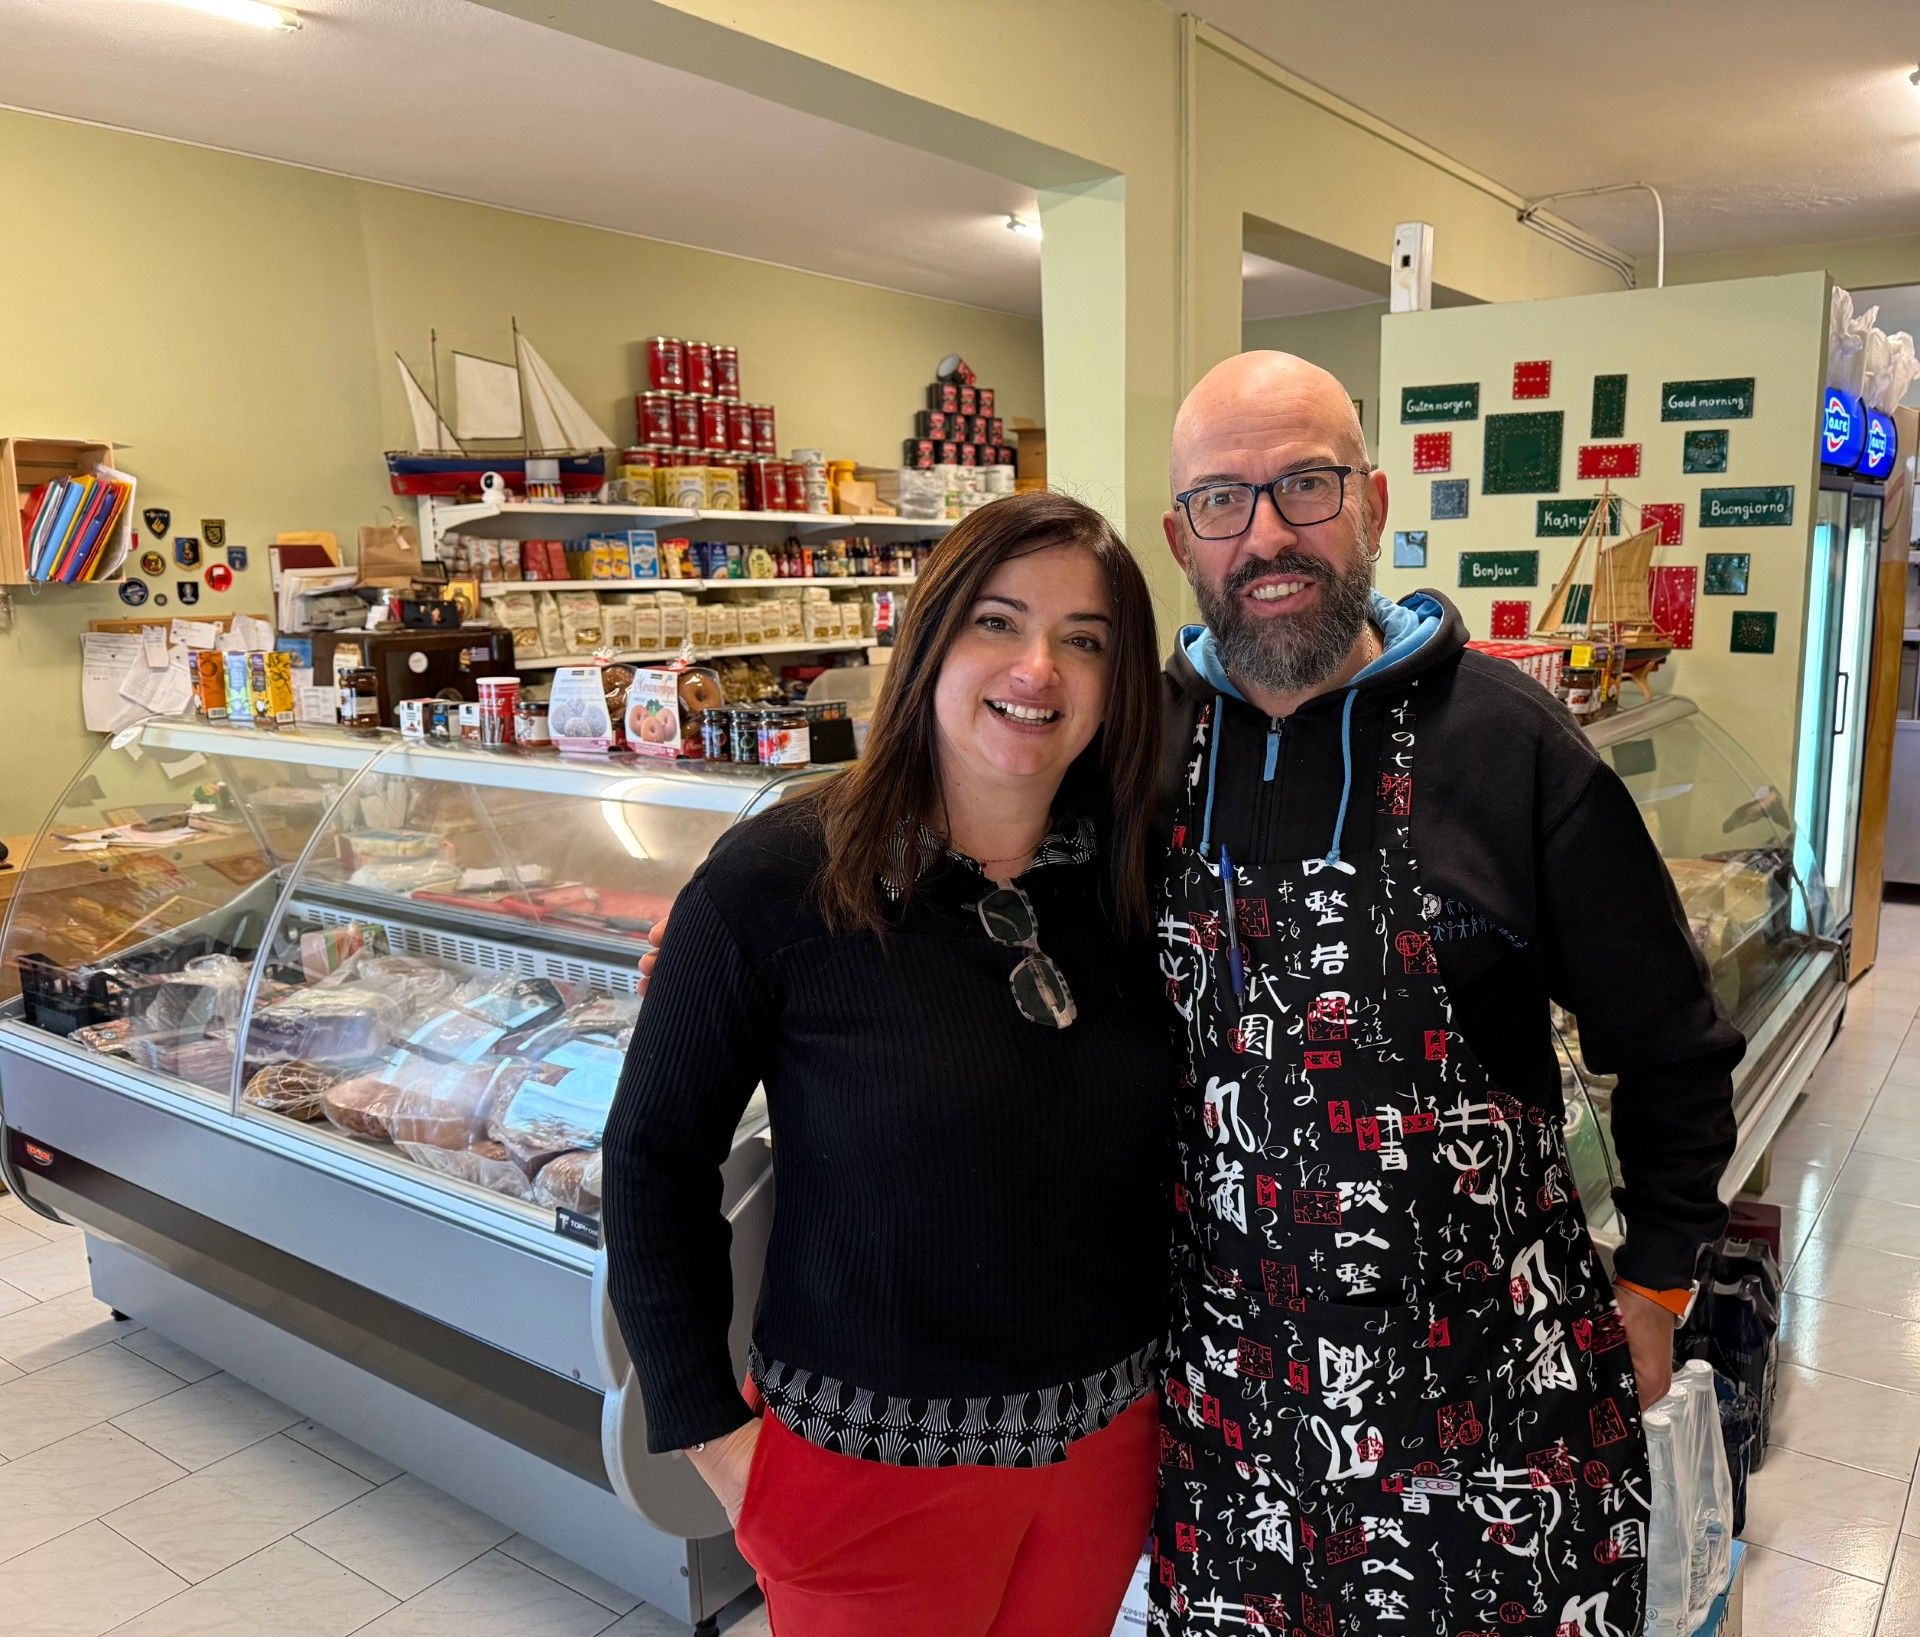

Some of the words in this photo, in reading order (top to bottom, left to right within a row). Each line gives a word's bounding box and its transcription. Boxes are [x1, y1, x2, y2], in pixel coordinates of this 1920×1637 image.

[1668, 394, 1697, 409] Good
[1698, 396, 1745, 411] morning
[1711, 500, 1784, 519] Buongiorno
[1472, 562, 1520, 581] Bonjour
